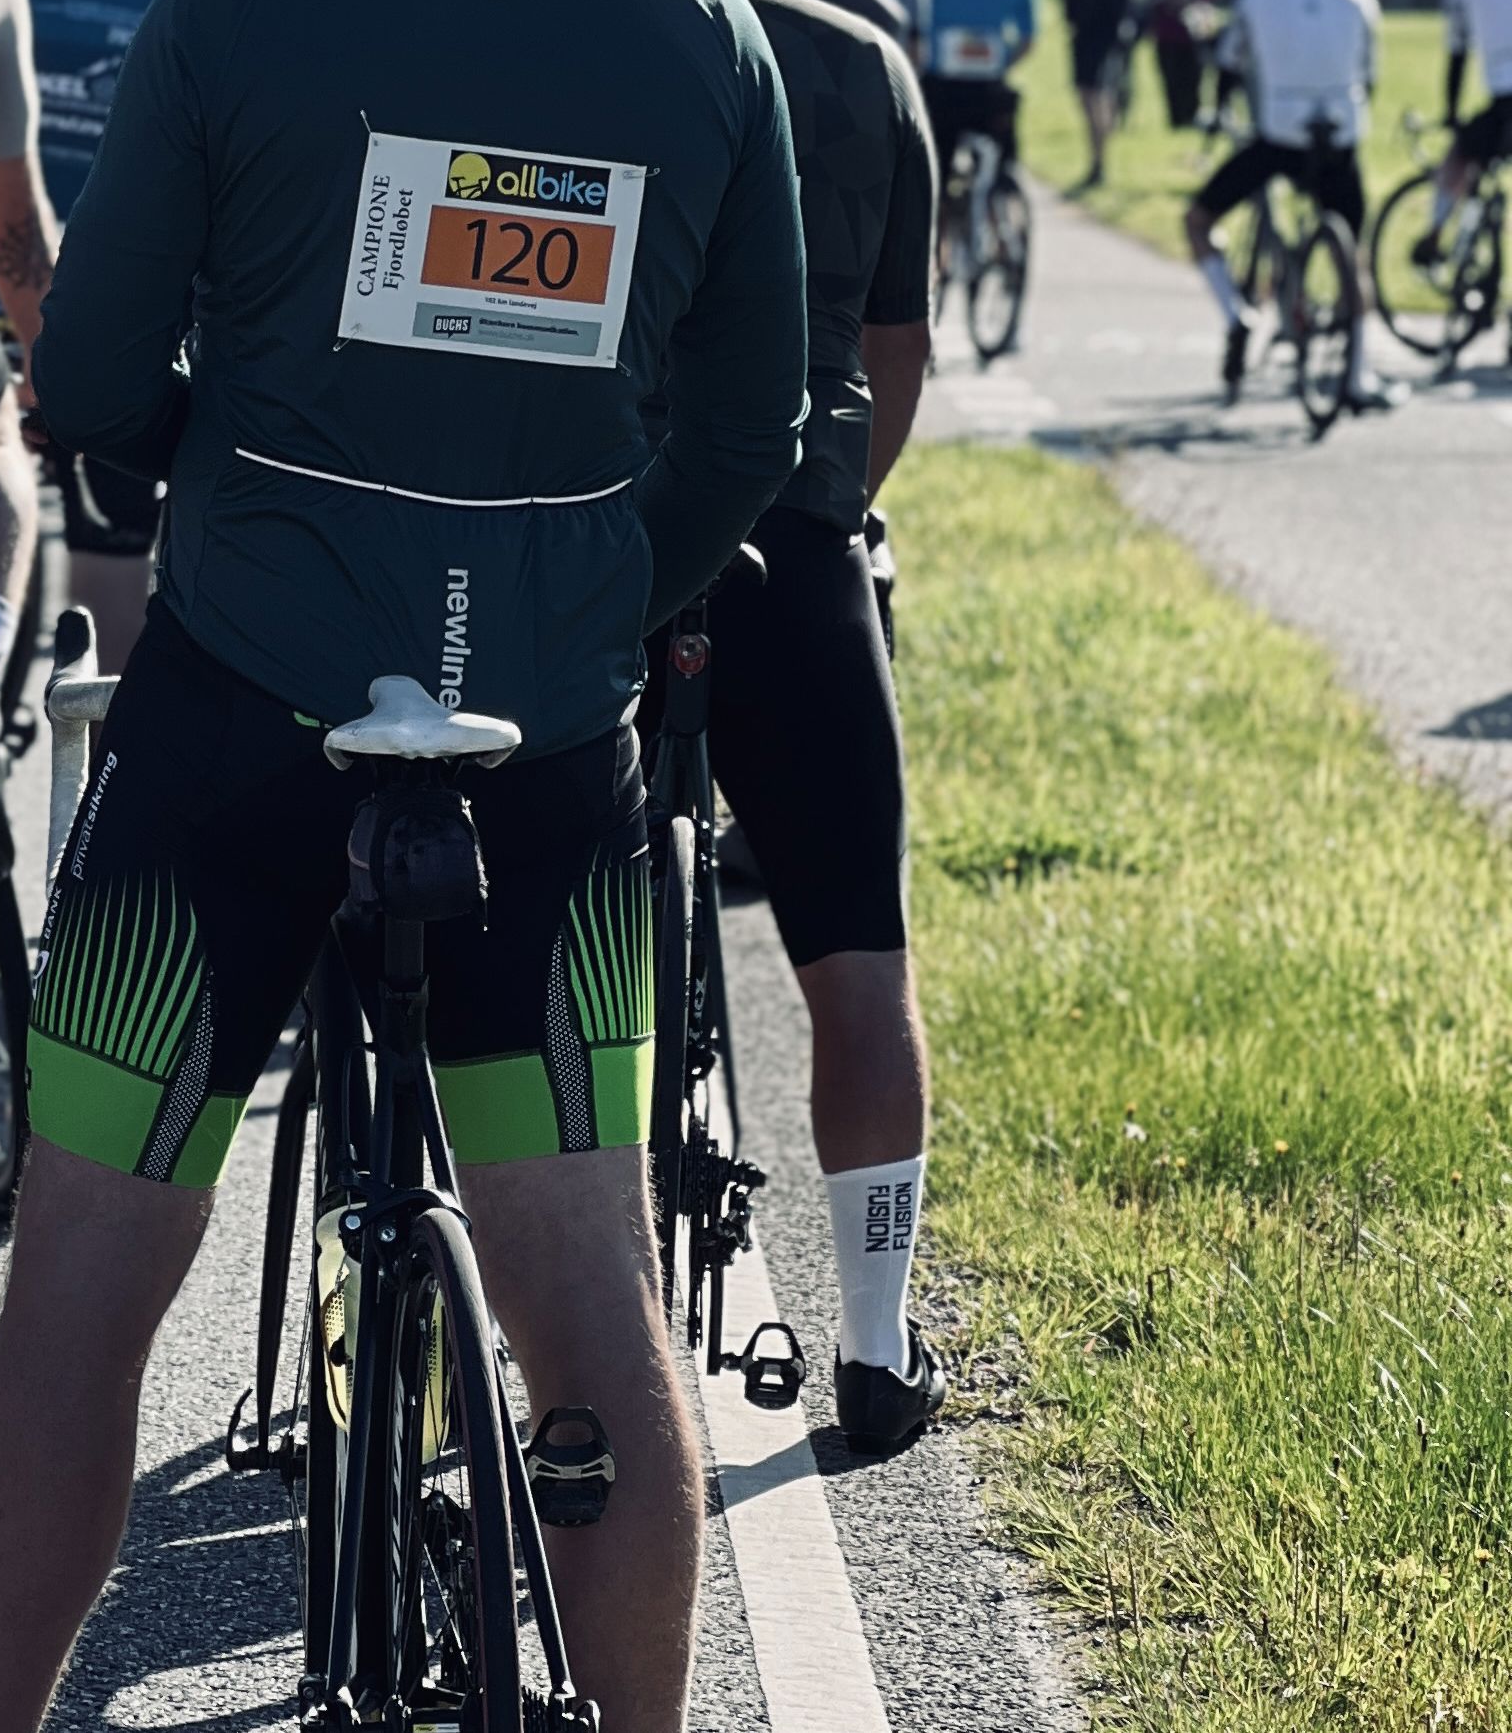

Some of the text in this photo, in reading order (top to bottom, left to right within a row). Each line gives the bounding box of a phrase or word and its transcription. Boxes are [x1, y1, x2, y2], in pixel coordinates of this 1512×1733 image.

[496, 164, 607, 206] allbike
[357, 175, 390, 296] CAMPIONE
[383, 188, 413, 290] Fjordløbet
[467, 219, 580, 292] 120
[435, 318, 469, 332] BUCHS
[438, 568, 472, 709] newline
[70, 751, 118, 881] privatsikring
[43, 887, 63, 940] BANK
[865, 1184, 891, 1253] FUSION
[892, 1181, 913, 1251] FUSION
